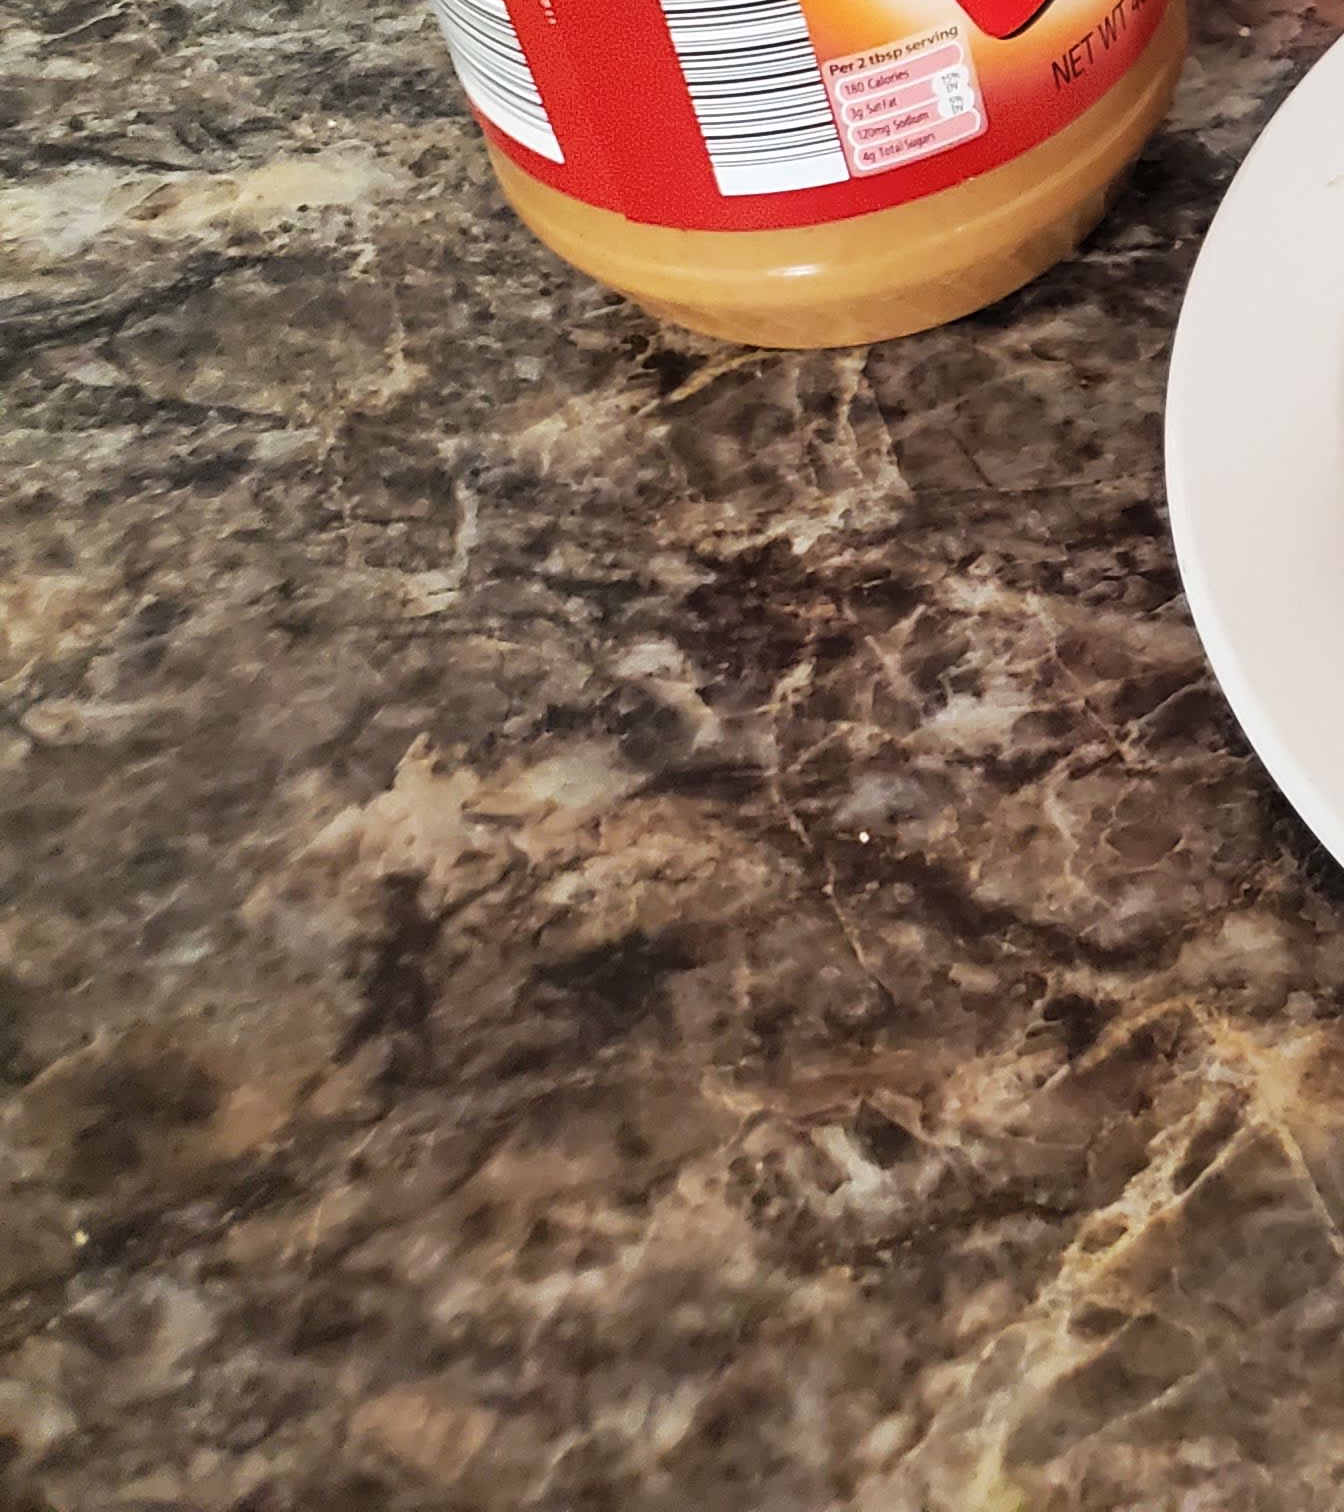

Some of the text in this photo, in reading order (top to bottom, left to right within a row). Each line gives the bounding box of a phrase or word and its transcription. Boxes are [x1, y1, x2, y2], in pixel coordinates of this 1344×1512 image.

[829, 25, 959, 78] Per 2 tbsp serving
[1051, 31, 1094, 90] NET
[845, 70, 909, 94] 180 Calories
[893, 111, 930, 130] Sodium
